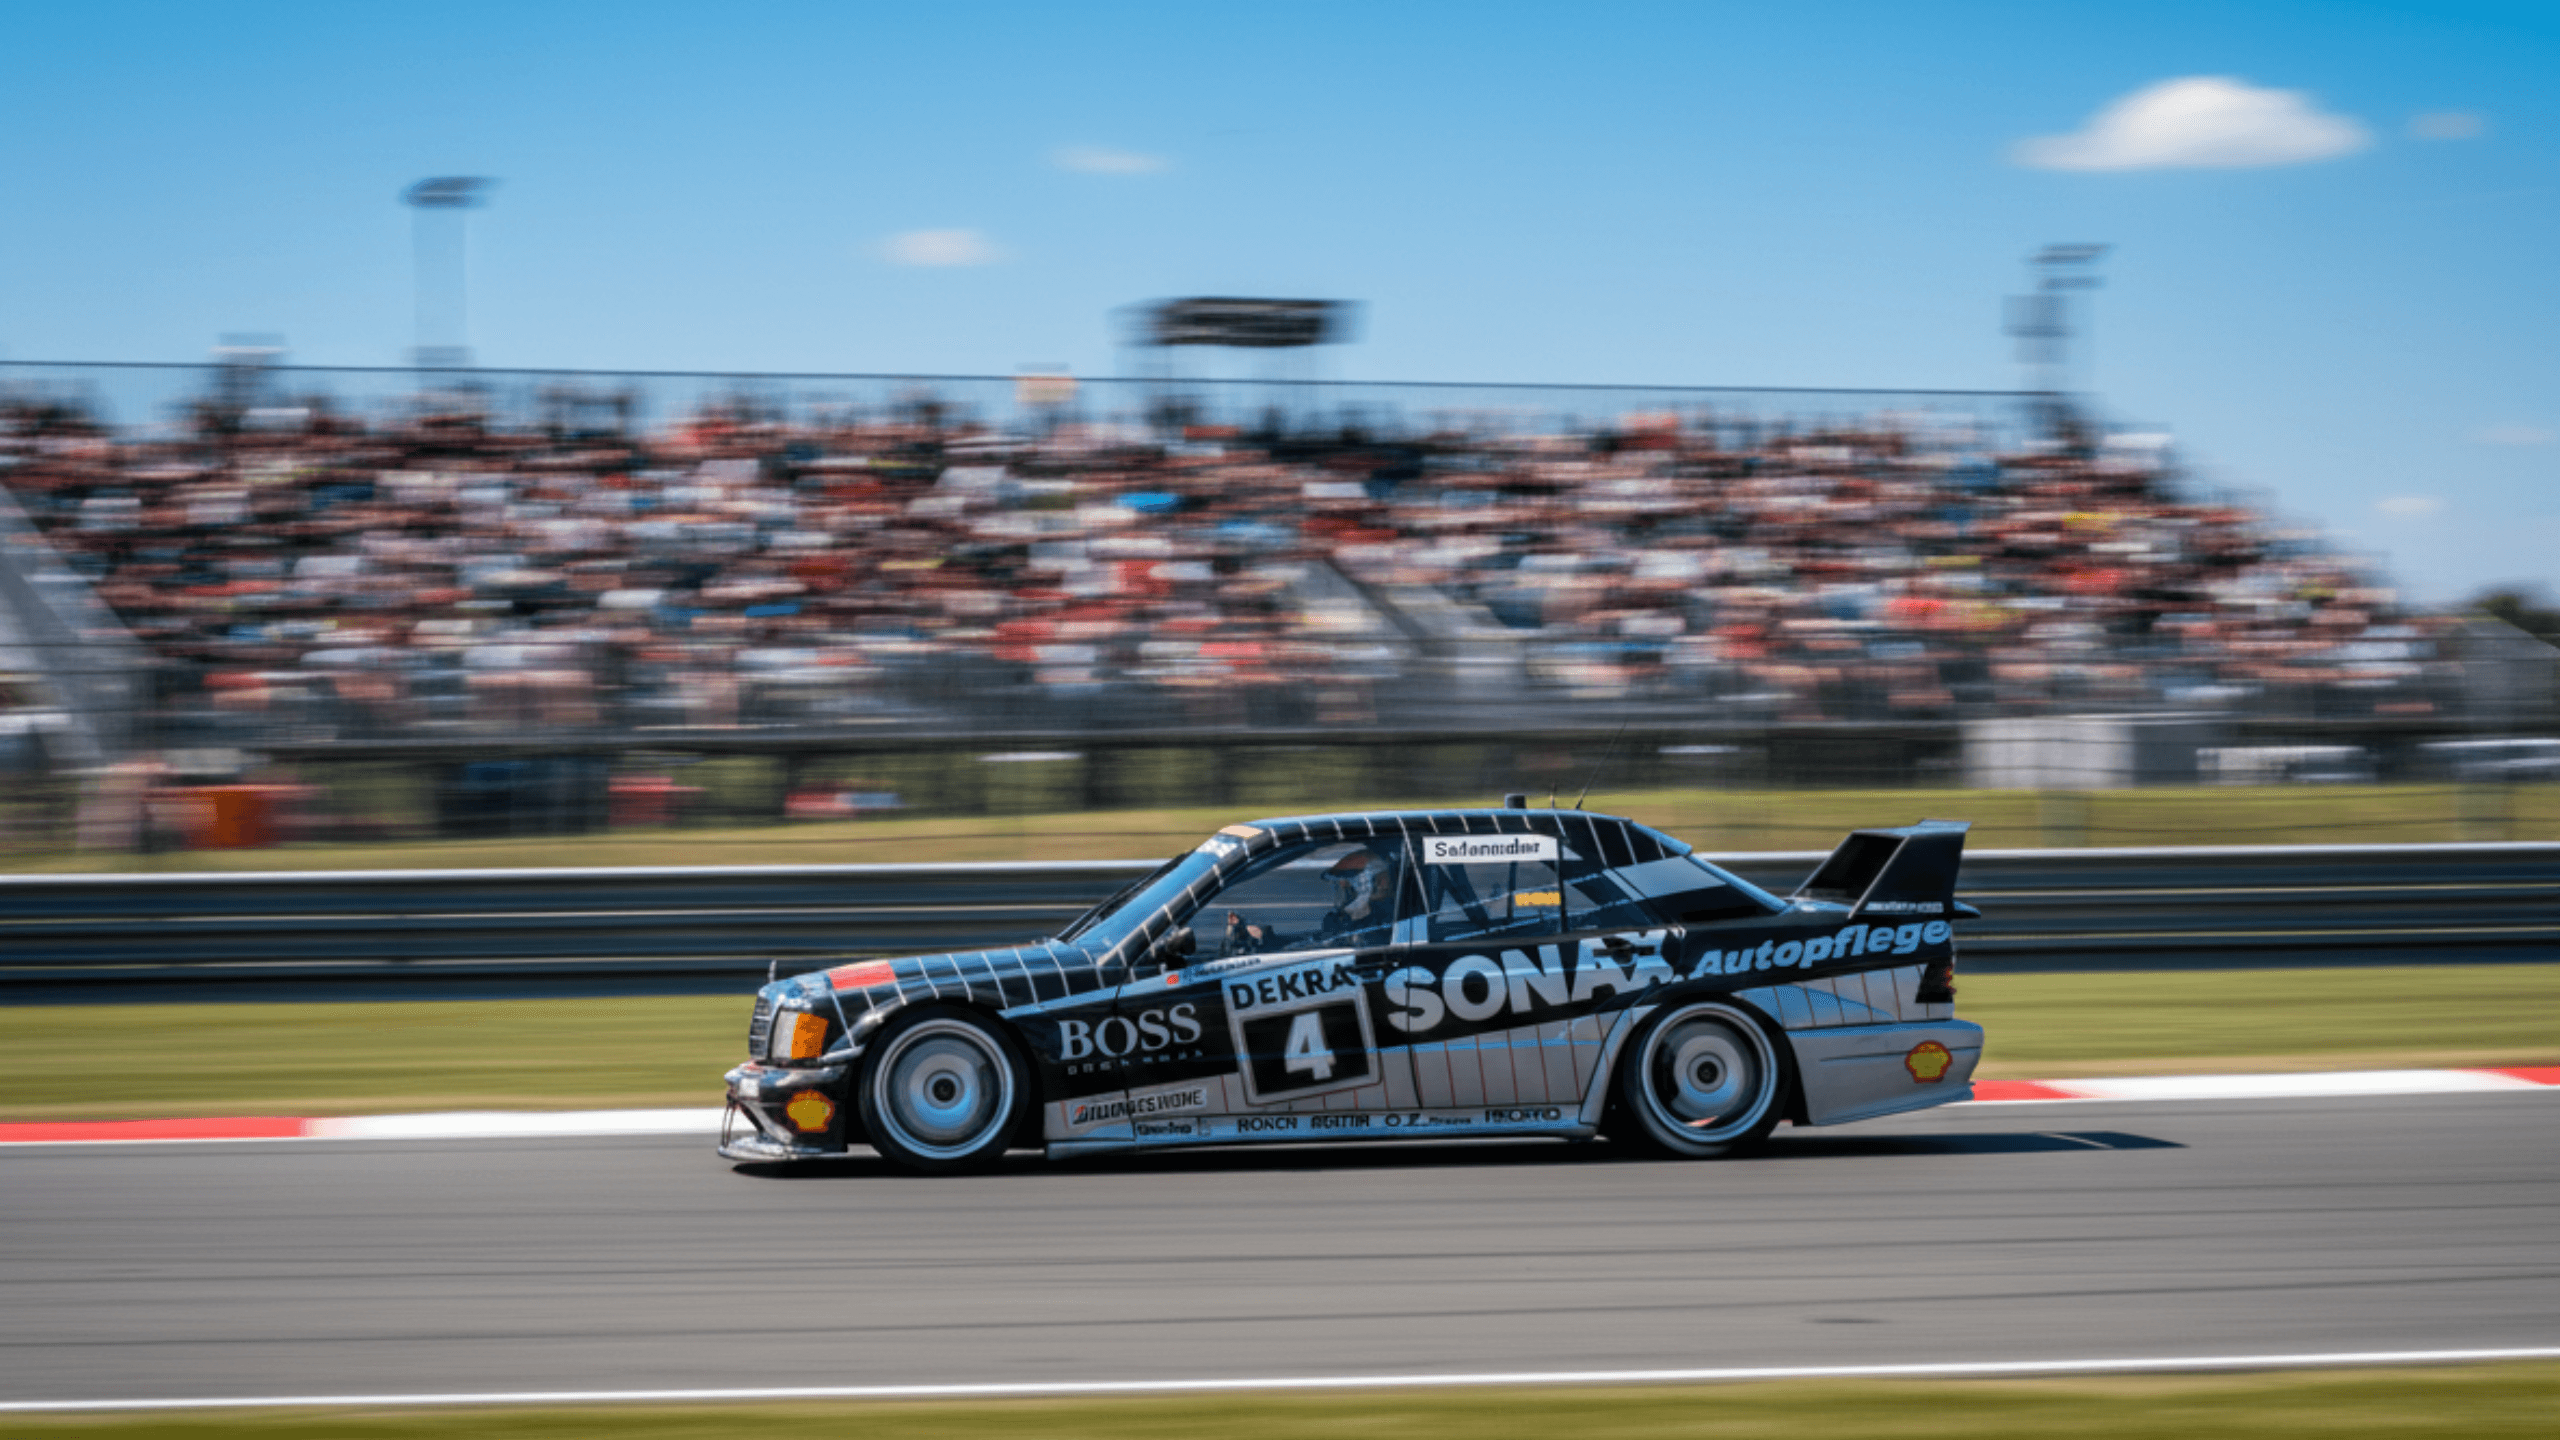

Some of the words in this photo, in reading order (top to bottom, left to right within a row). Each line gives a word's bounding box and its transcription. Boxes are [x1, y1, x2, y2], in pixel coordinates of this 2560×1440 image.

[1688, 920, 1950, 979] Autopflege
[1230, 963, 1356, 1010] DEKRA
[1058, 1003, 1201, 1060] BOSS
[1284, 1011, 1336, 1080] 4
